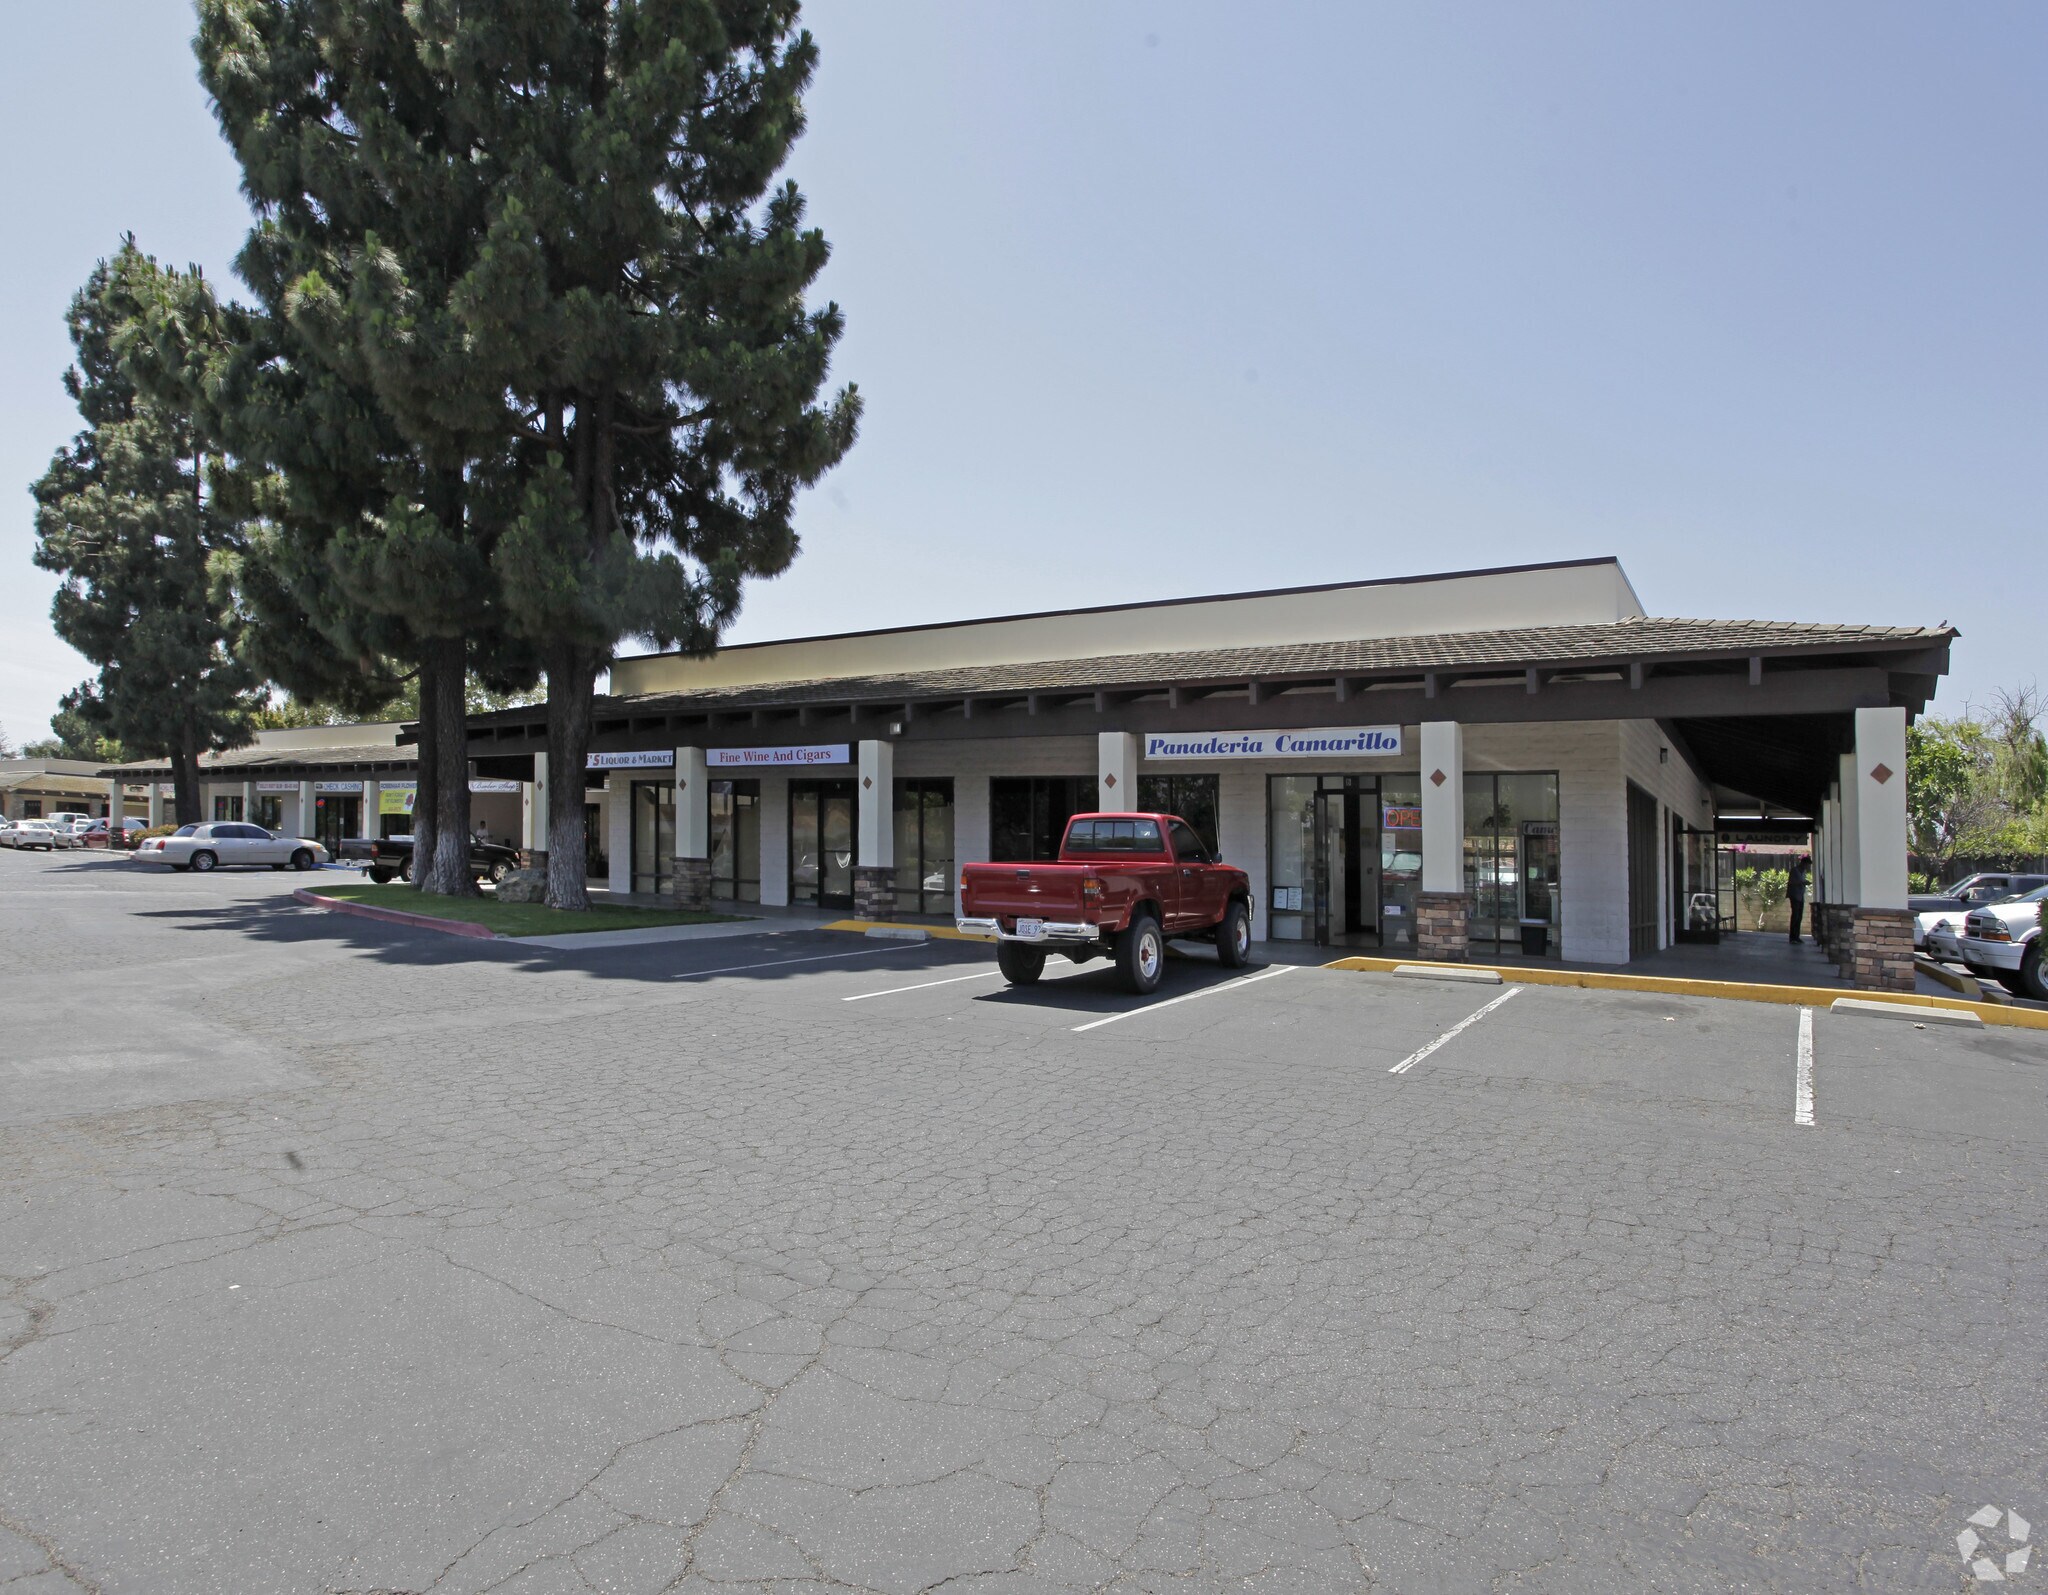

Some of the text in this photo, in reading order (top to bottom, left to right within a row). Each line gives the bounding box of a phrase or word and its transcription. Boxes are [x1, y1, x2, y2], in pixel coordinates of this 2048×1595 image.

[1148, 732, 1398, 755] Panaderia Camarillo
[631, 756, 637, 764] &
[720, 748, 832, 763] Fine Wine And Cigars
[341, 782, 362, 791] CASHING
[1386, 809, 1422, 827] OPE
[1735, 833, 1804, 843] LAUNDRY
